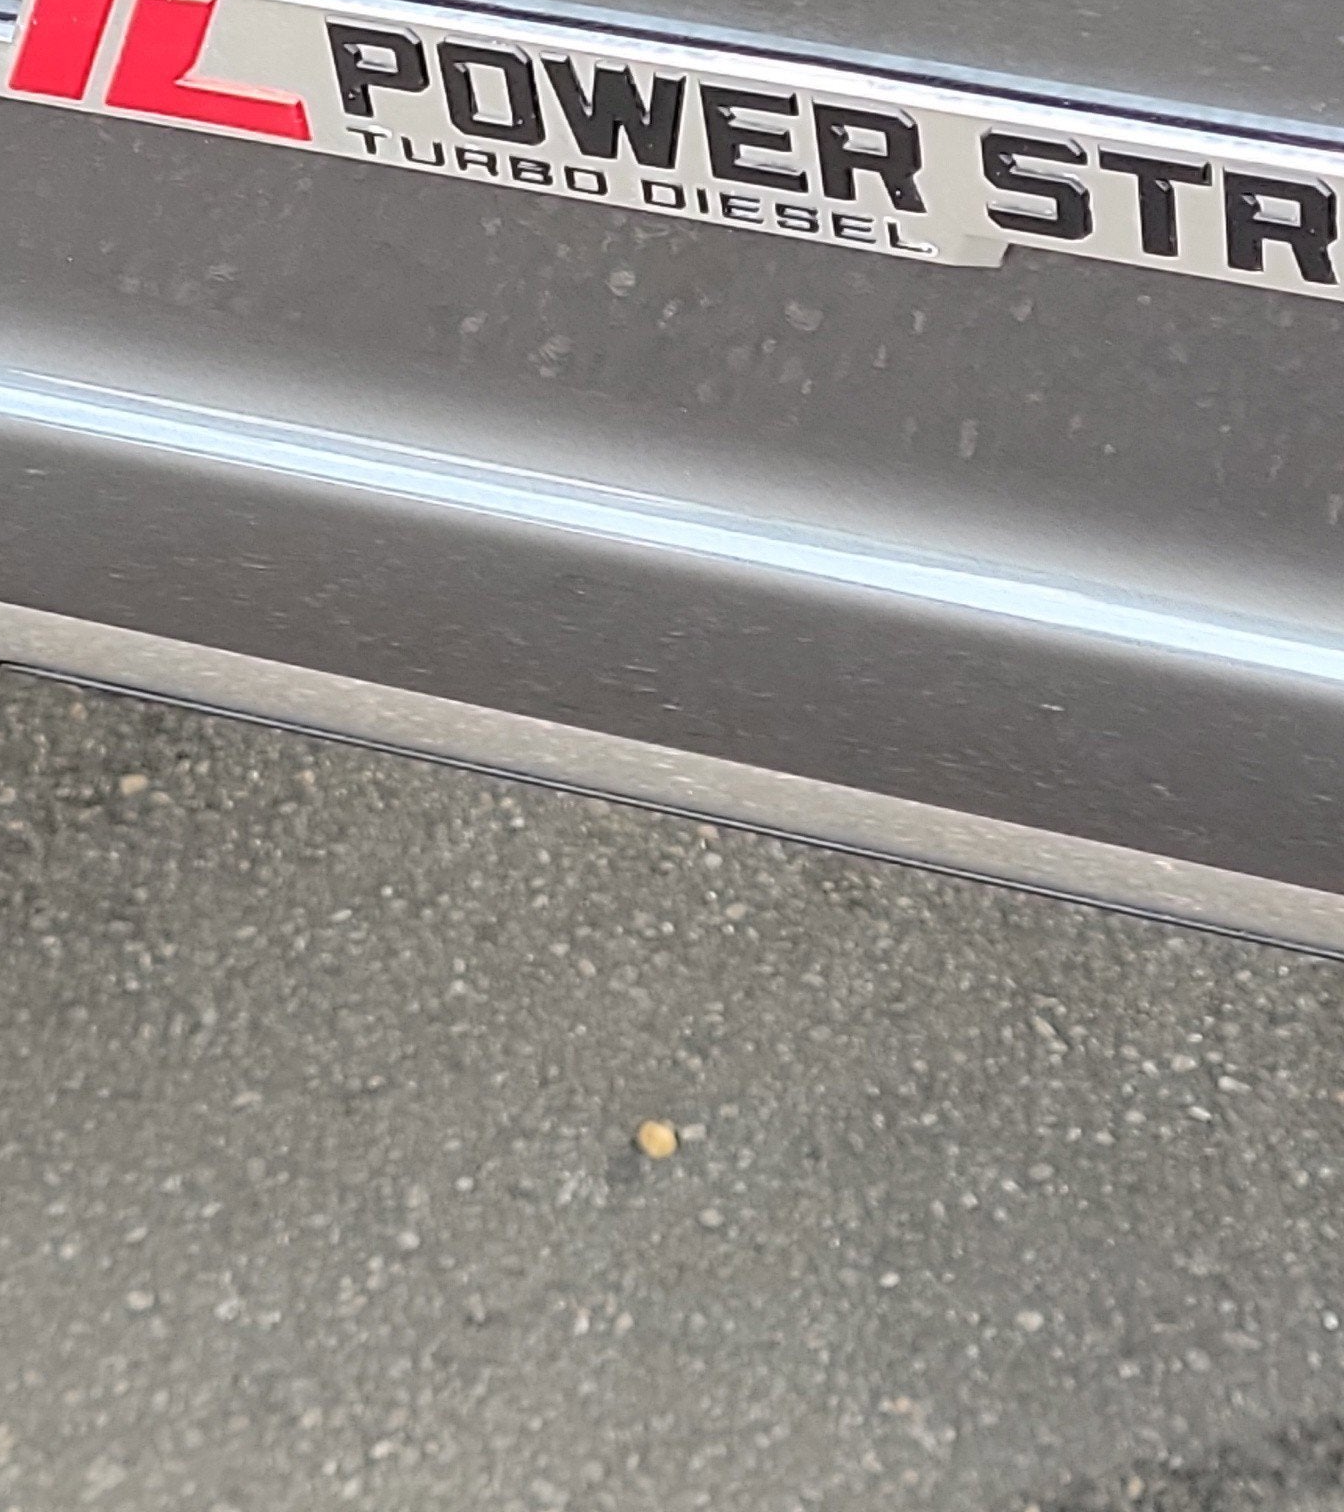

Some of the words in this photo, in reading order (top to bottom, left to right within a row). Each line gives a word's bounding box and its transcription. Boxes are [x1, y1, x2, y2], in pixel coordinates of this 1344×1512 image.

[325, 14, 928, 213] POWER
[345, 126, 609, 197] TURBO
[641, 178, 940, 258] DIESEL
